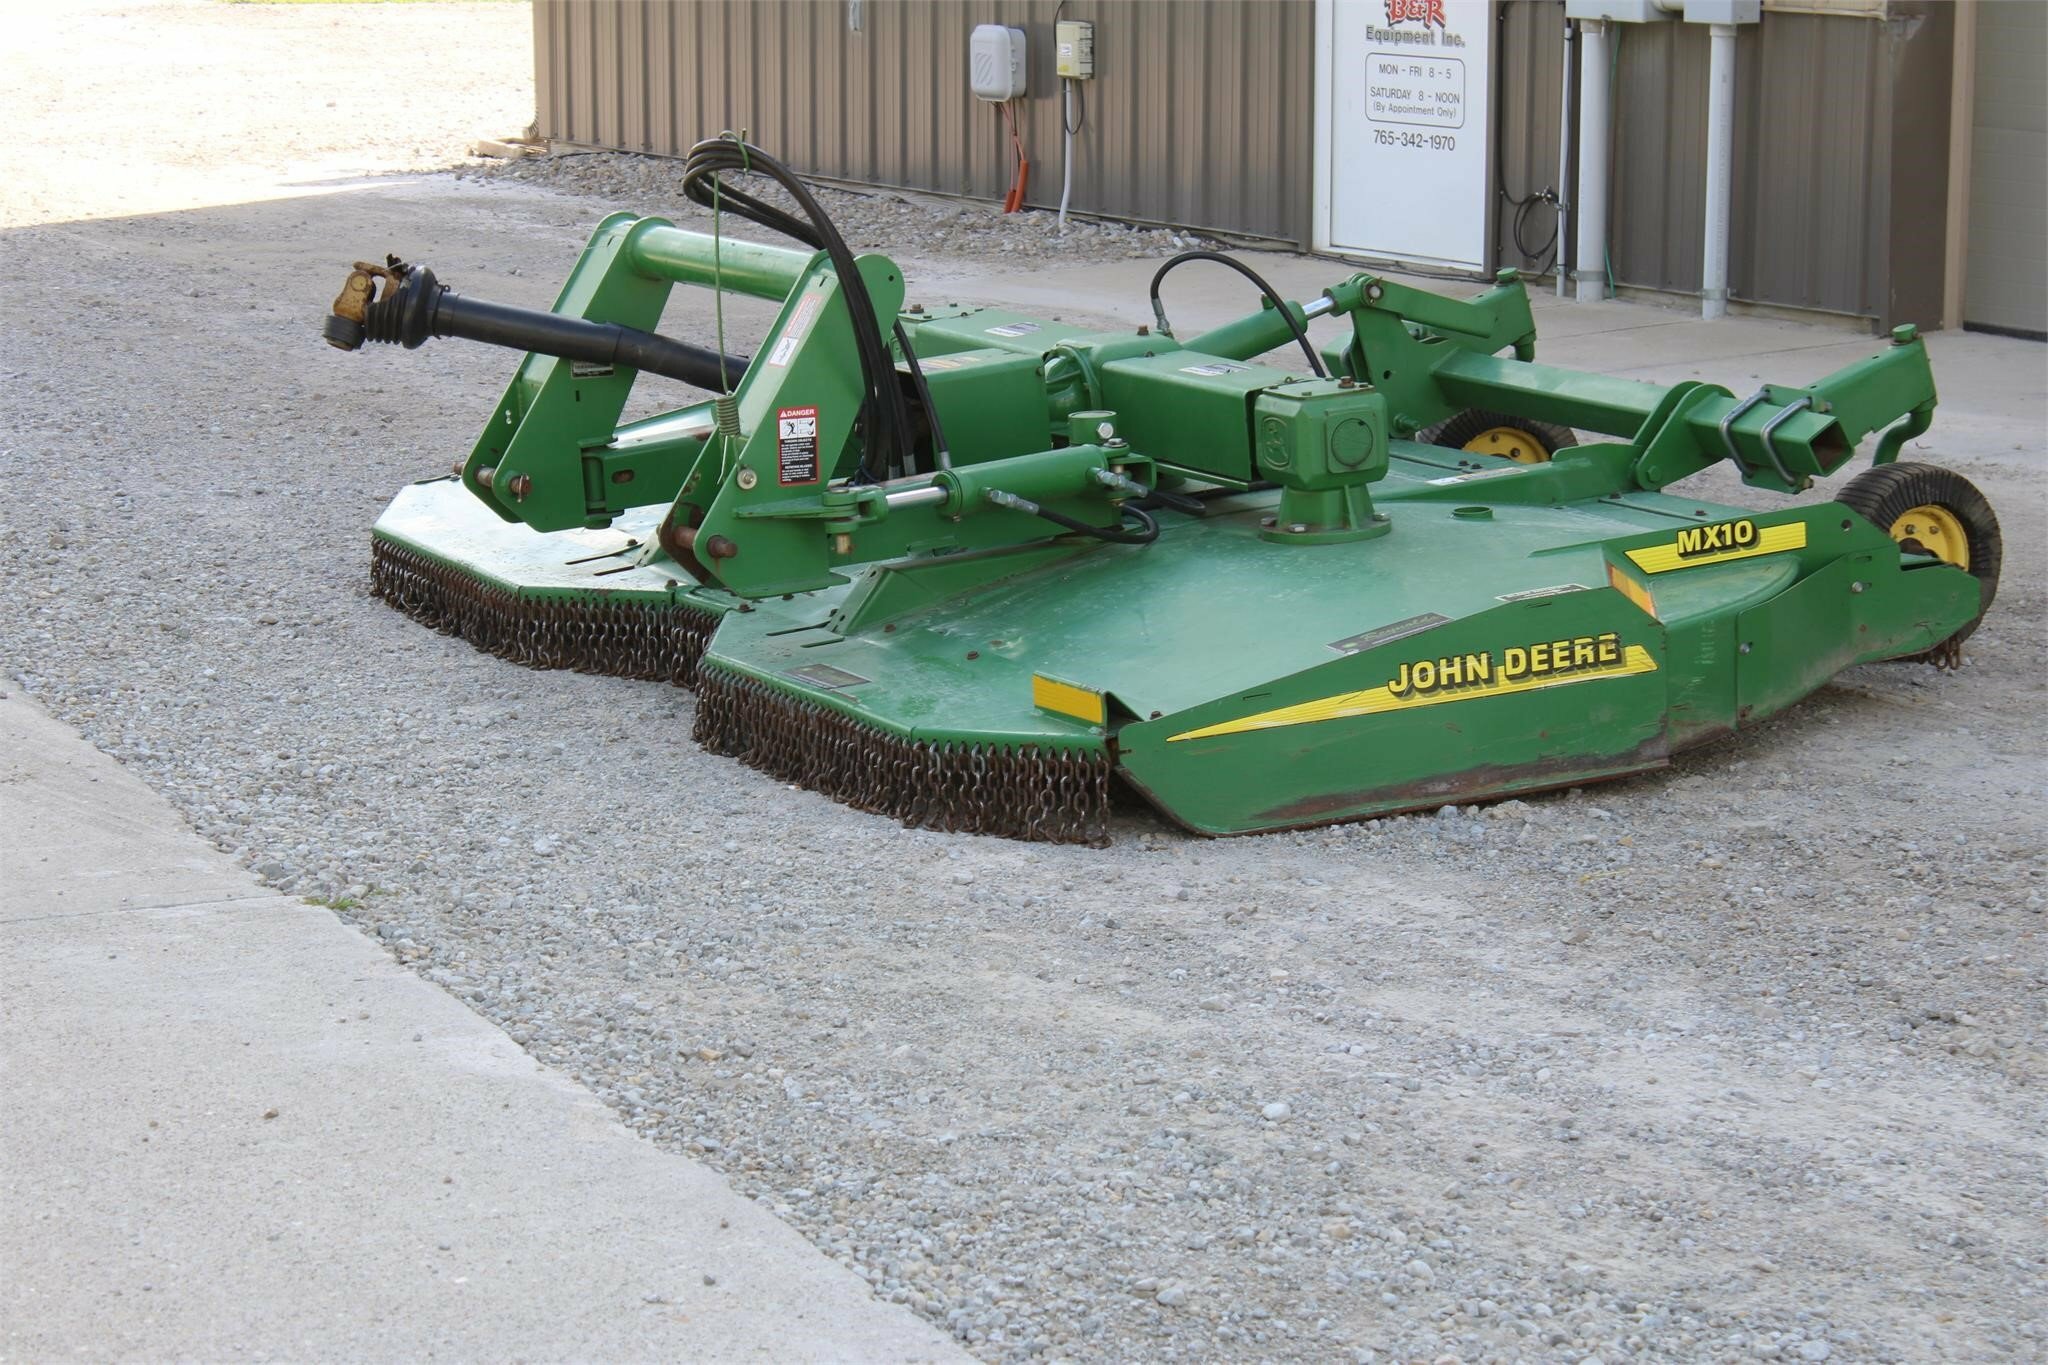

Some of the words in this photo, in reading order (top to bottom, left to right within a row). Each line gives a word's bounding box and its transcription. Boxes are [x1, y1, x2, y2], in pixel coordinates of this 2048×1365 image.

[1384, 0, 1446, 30] B&R
[1366, 25, 1436, 46] Equipment
[1441, 30, 1466, 47] Inc.
[1379, 64, 1398, 75] MON
[1409, 66, 1422, 77] FRI
[1429, 67, 1434, 78] 8
[1446, 68, 1451, 79] 5
[1370, 87, 1412, 100] SATURDAY
[1418, 90, 1424, 101] 8
[1435, 93, 1460, 104] NOON
[1373, 101, 1385, 113] (By
[1388, 103, 1434, 116] Appointment
[1437, 107, 1457, 119] Only)
[1373, 130, 1456, 151] 765-342-1970
[786, 409, 815, 417] DANGER
[1677, 519, 1756, 557] MX10
[1388, 653, 1494, 696] JOHN
[1503, 633, 1621, 680] DEERE
